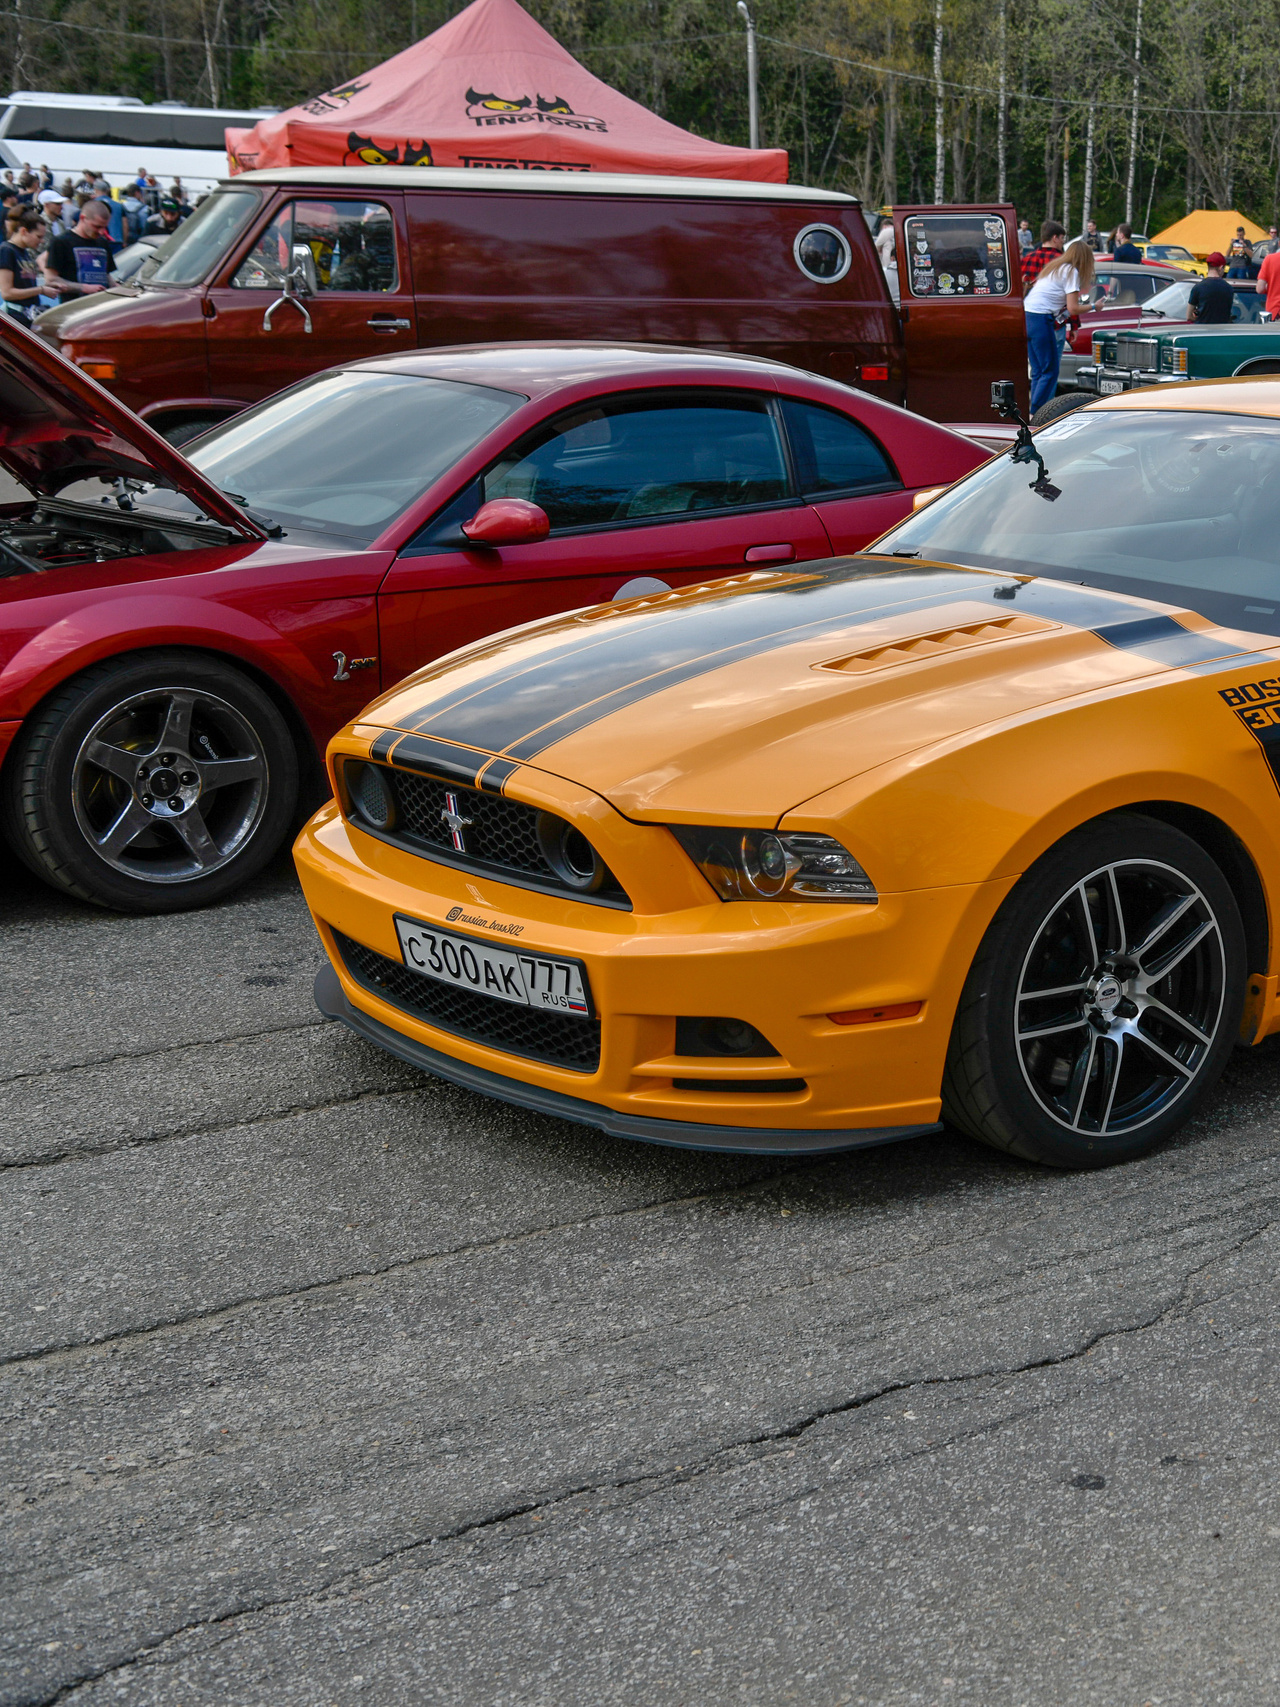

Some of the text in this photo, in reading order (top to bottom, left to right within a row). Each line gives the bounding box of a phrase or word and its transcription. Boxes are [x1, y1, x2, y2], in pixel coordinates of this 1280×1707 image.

[457, 912, 525, 936] russian_boss302
[407, 931, 570, 998] С300АК 777
[541, 991, 568, 1008] RUS
